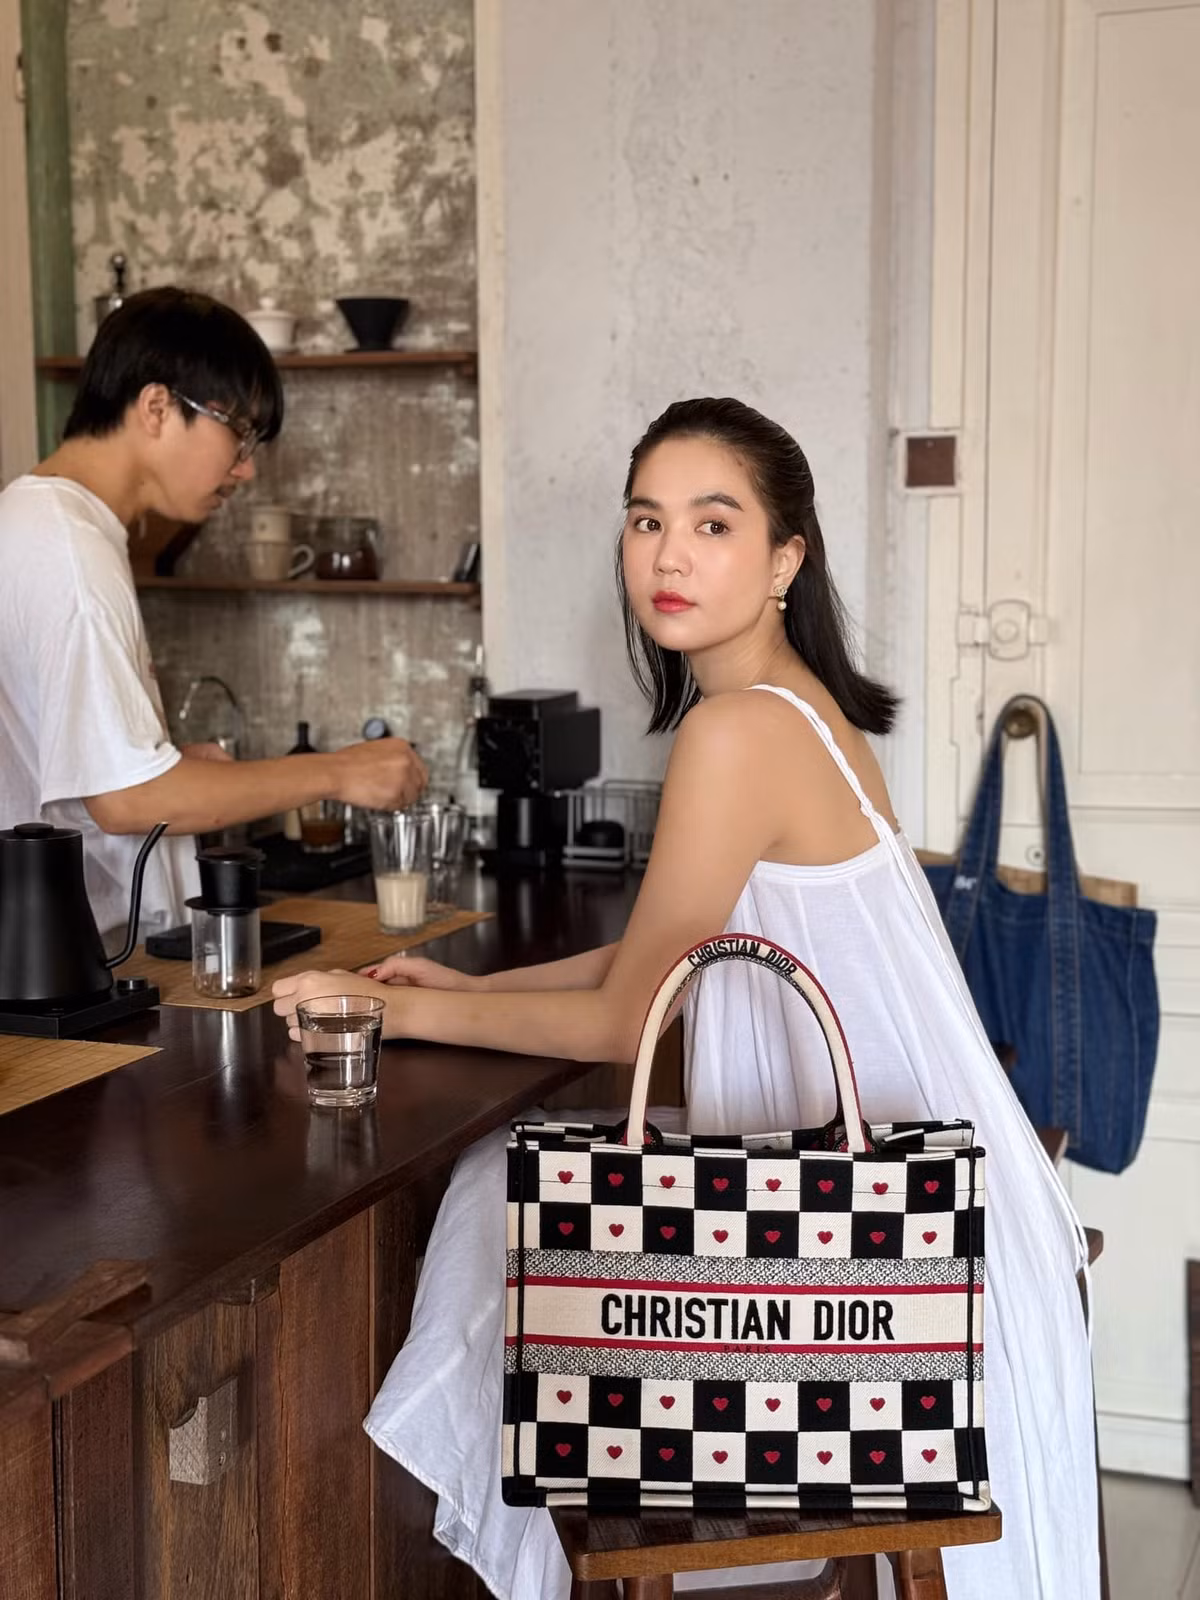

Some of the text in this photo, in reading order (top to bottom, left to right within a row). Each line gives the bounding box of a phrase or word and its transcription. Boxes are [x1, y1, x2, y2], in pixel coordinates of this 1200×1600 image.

[687, 938, 798, 976] CHRISTIAN DIOR
[601, 1293, 895, 1341] CHRISTIAN DIOR
[723, 1345, 770, 1353] PARIS
